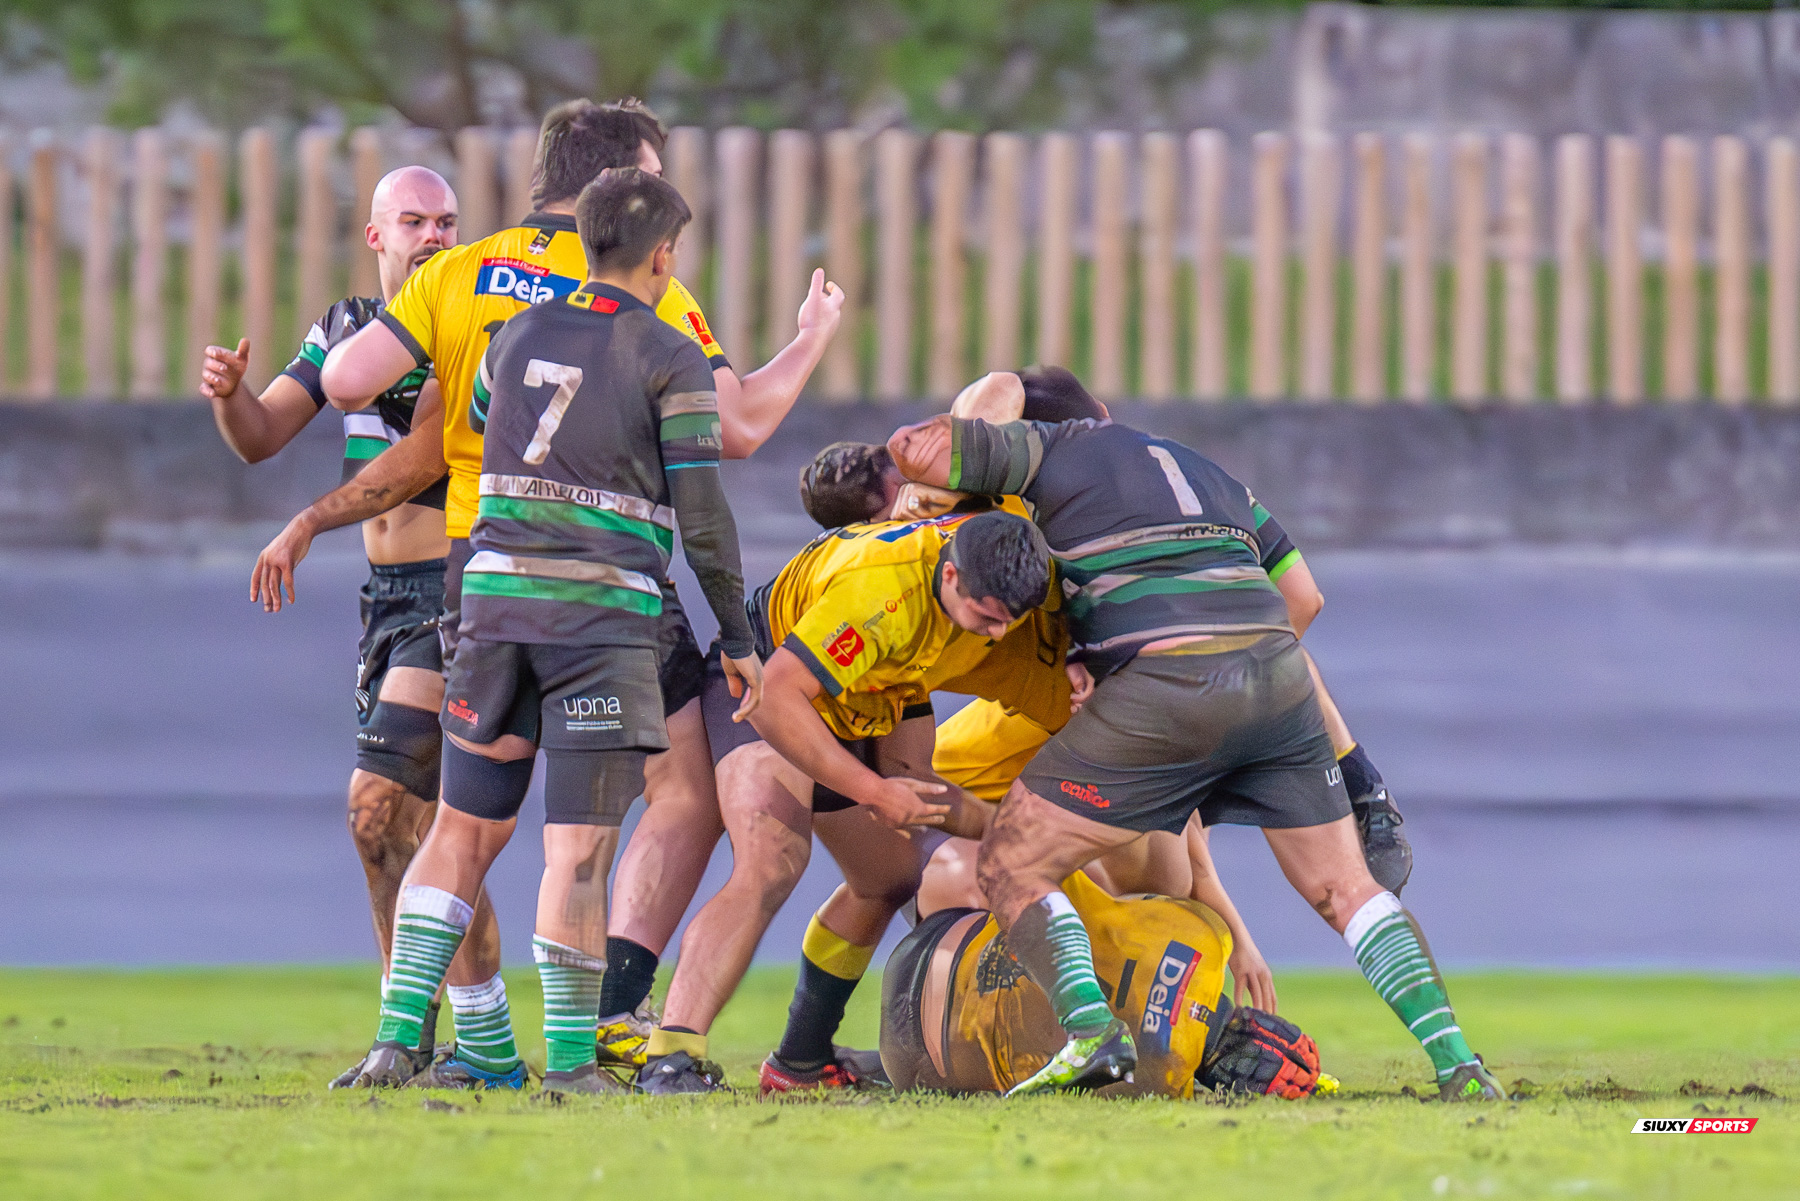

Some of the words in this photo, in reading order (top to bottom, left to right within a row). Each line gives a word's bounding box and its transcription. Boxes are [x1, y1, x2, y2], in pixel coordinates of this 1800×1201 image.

[488, 266, 554, 304] Deia
[522, 358, 583, 465] 7
[1147, 445, 1203, 516] 1
[563, 696, 623, 721] upna
[1142, 955, 1188, 1034] Deia
